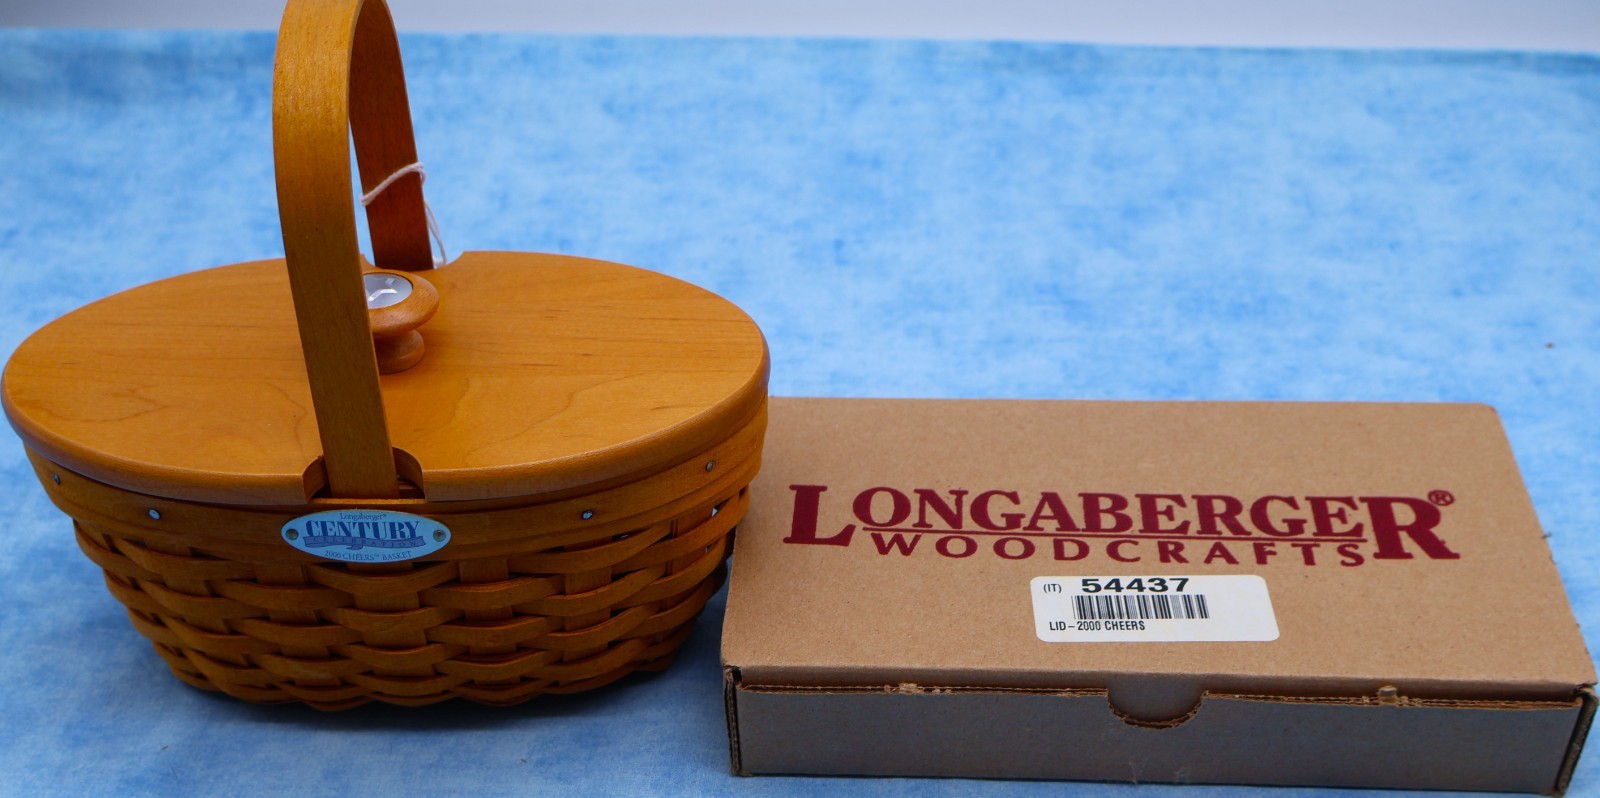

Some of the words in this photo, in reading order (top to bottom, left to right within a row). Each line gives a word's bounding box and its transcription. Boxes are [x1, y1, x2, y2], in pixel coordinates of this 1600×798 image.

[305, 519, 420, 540] CENTURY
[324, 550, 341, 559] 2000
[382, 550, 413, 561] BASKET
[871, 531, 1367, 568] WOODCRAFTS
[1043, 583, 1062, 594] (IT)
[1081, 578, 1190, 593] 54437
[1104, 620, 1146, 631] CHEERS
